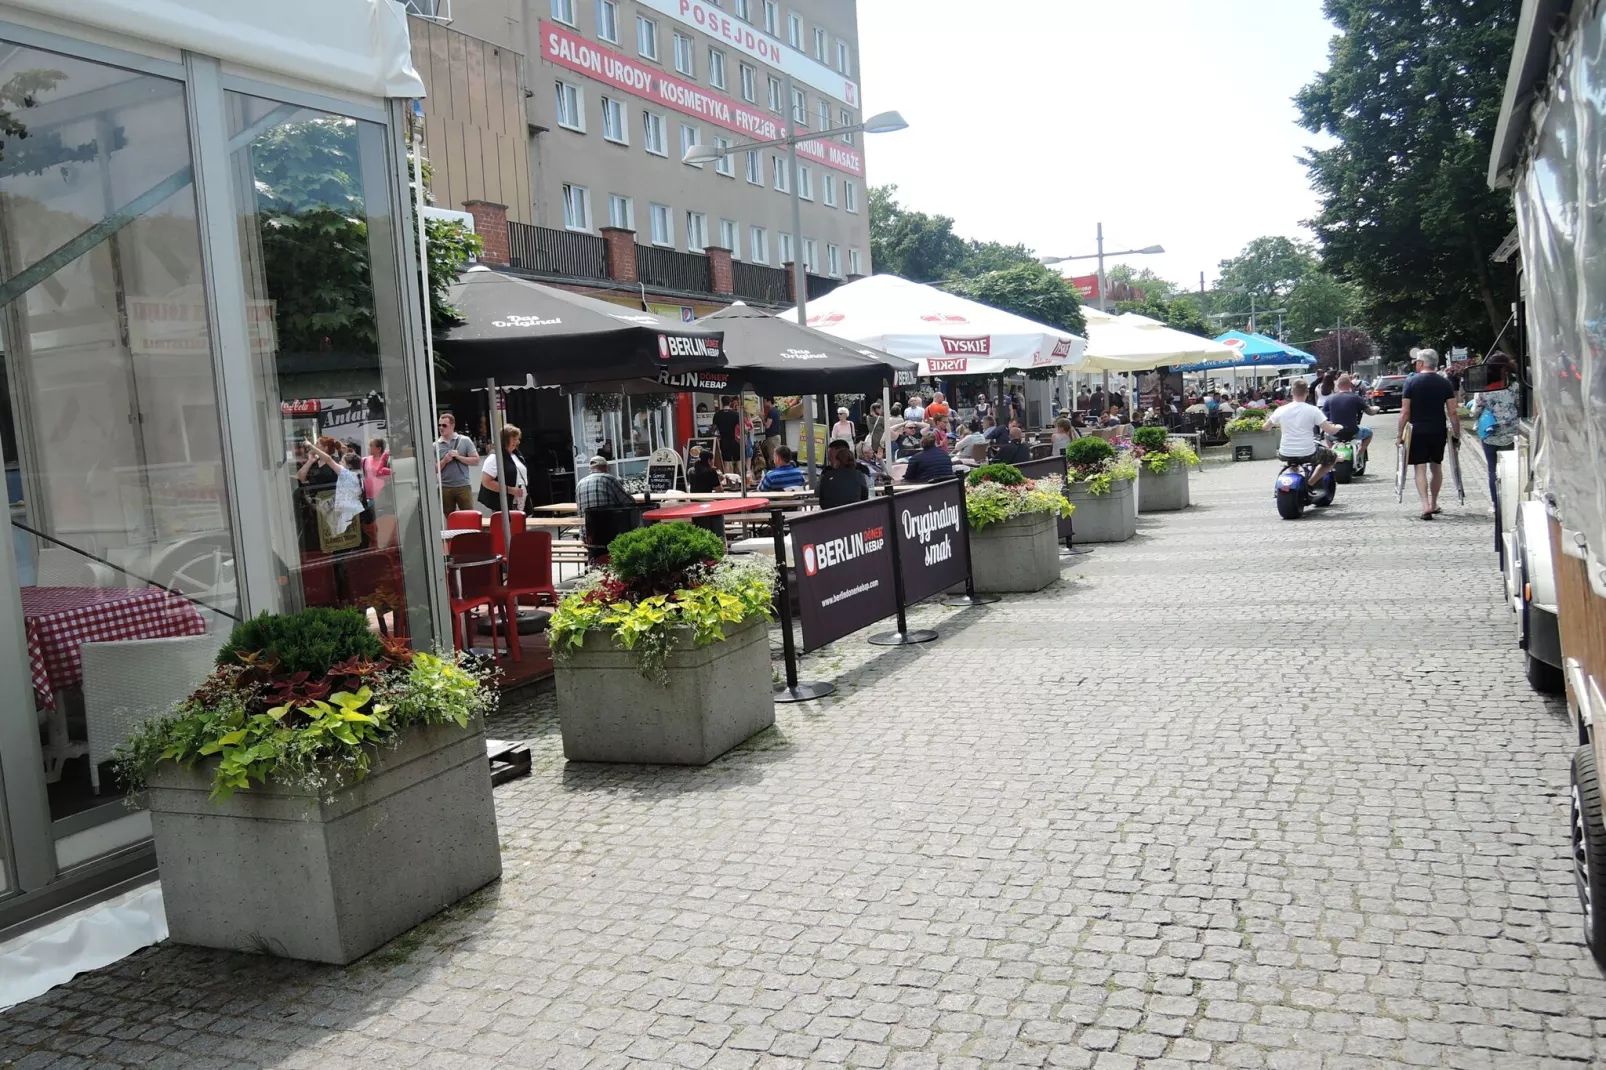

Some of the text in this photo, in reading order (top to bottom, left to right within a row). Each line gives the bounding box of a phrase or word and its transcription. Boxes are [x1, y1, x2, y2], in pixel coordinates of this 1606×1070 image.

[679, 0, 781, 64] POSEJDON
[549, 33, 602, 74] SALON
[603, 56, 651, 92] URODY
[659, 79, 730, 123] KOSMETYKA
[735, 109, 776, 140] FRYZJER
[829, 146, 860, 172] MASAŻE
[667, 336, 708, 357] BERLIN
[944, 339, 988, 353] TYSKIE
[699, 380, 728, 389] KEBAP
[322, 408, 369, 428] Antar
[901, 501, 960, 544] Oryginalny
[815, 531, 865, 570] BERLIN
[864, 538, 884, 554] KEBAP
[924, 533, 952, 567] smak
